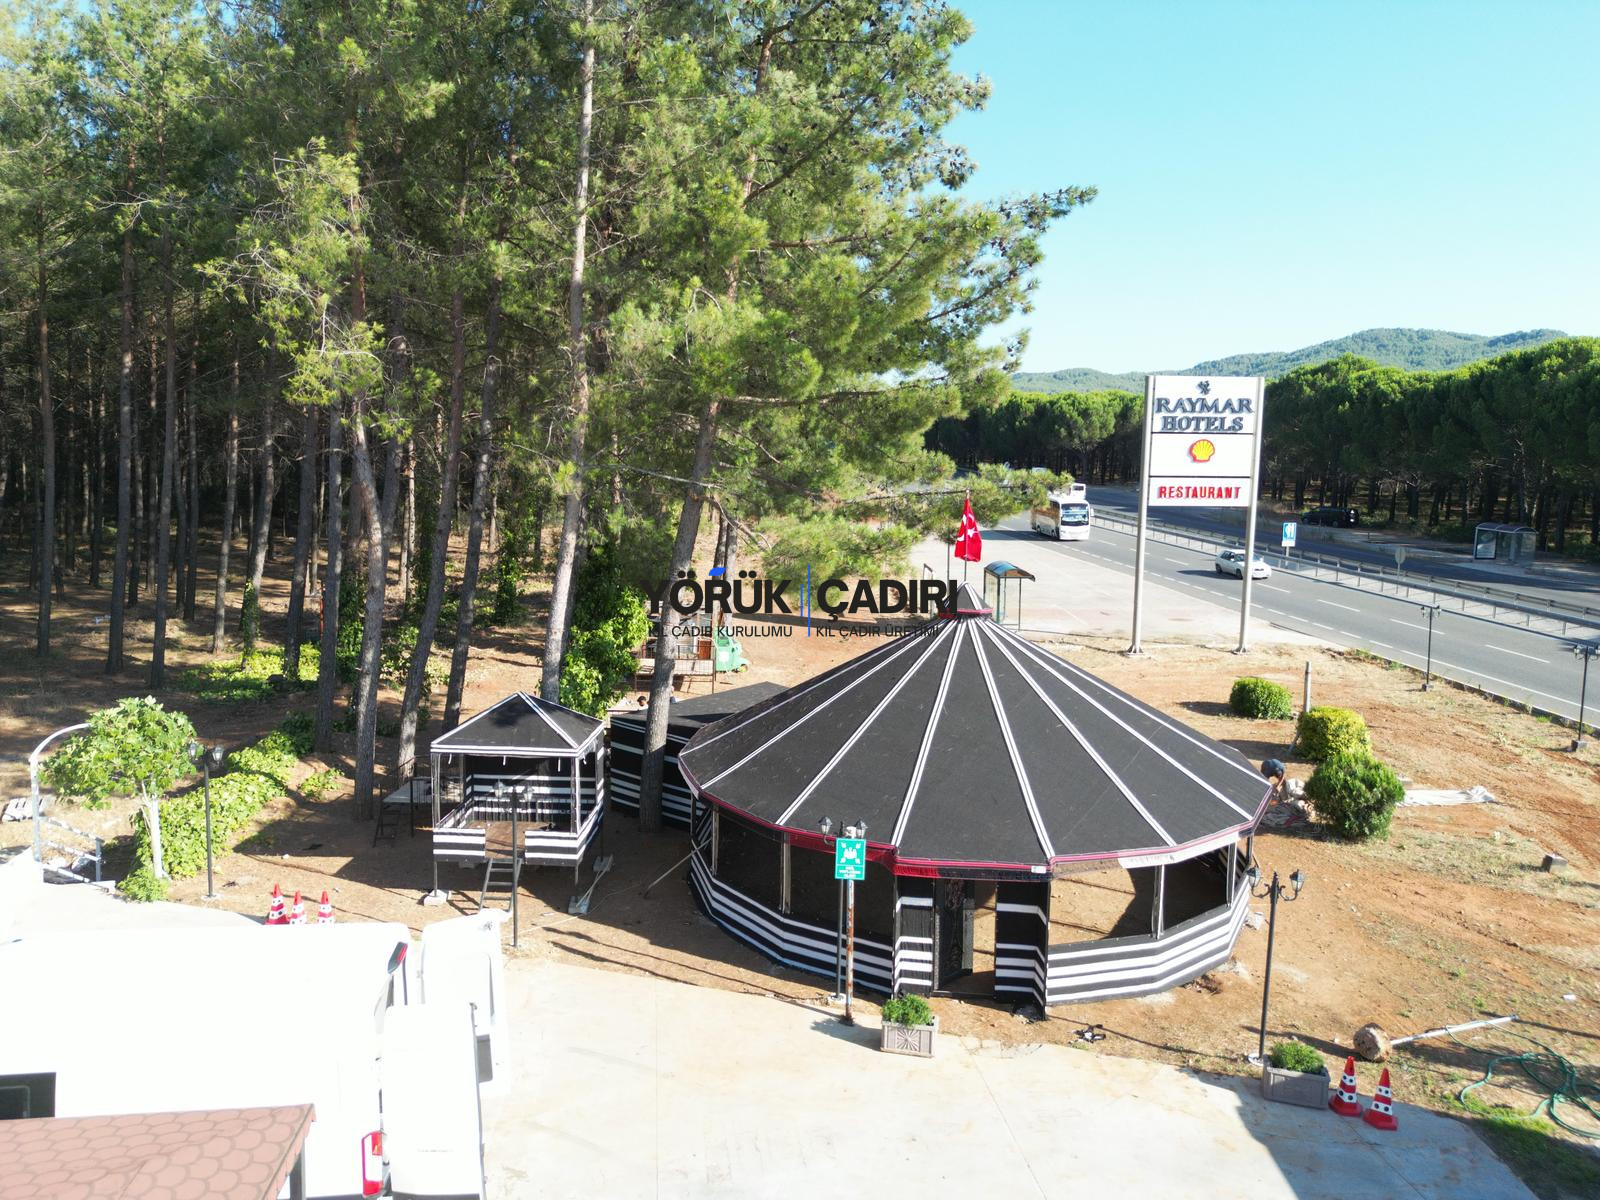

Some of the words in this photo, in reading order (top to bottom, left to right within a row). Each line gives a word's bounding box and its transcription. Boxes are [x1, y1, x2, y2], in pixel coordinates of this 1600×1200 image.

[1155, 397, 1254, 414] RAYMAR
[1160, 415, 1244, 432] HOTELS
[1157, 486, 1241, 499] RESTAURANT
